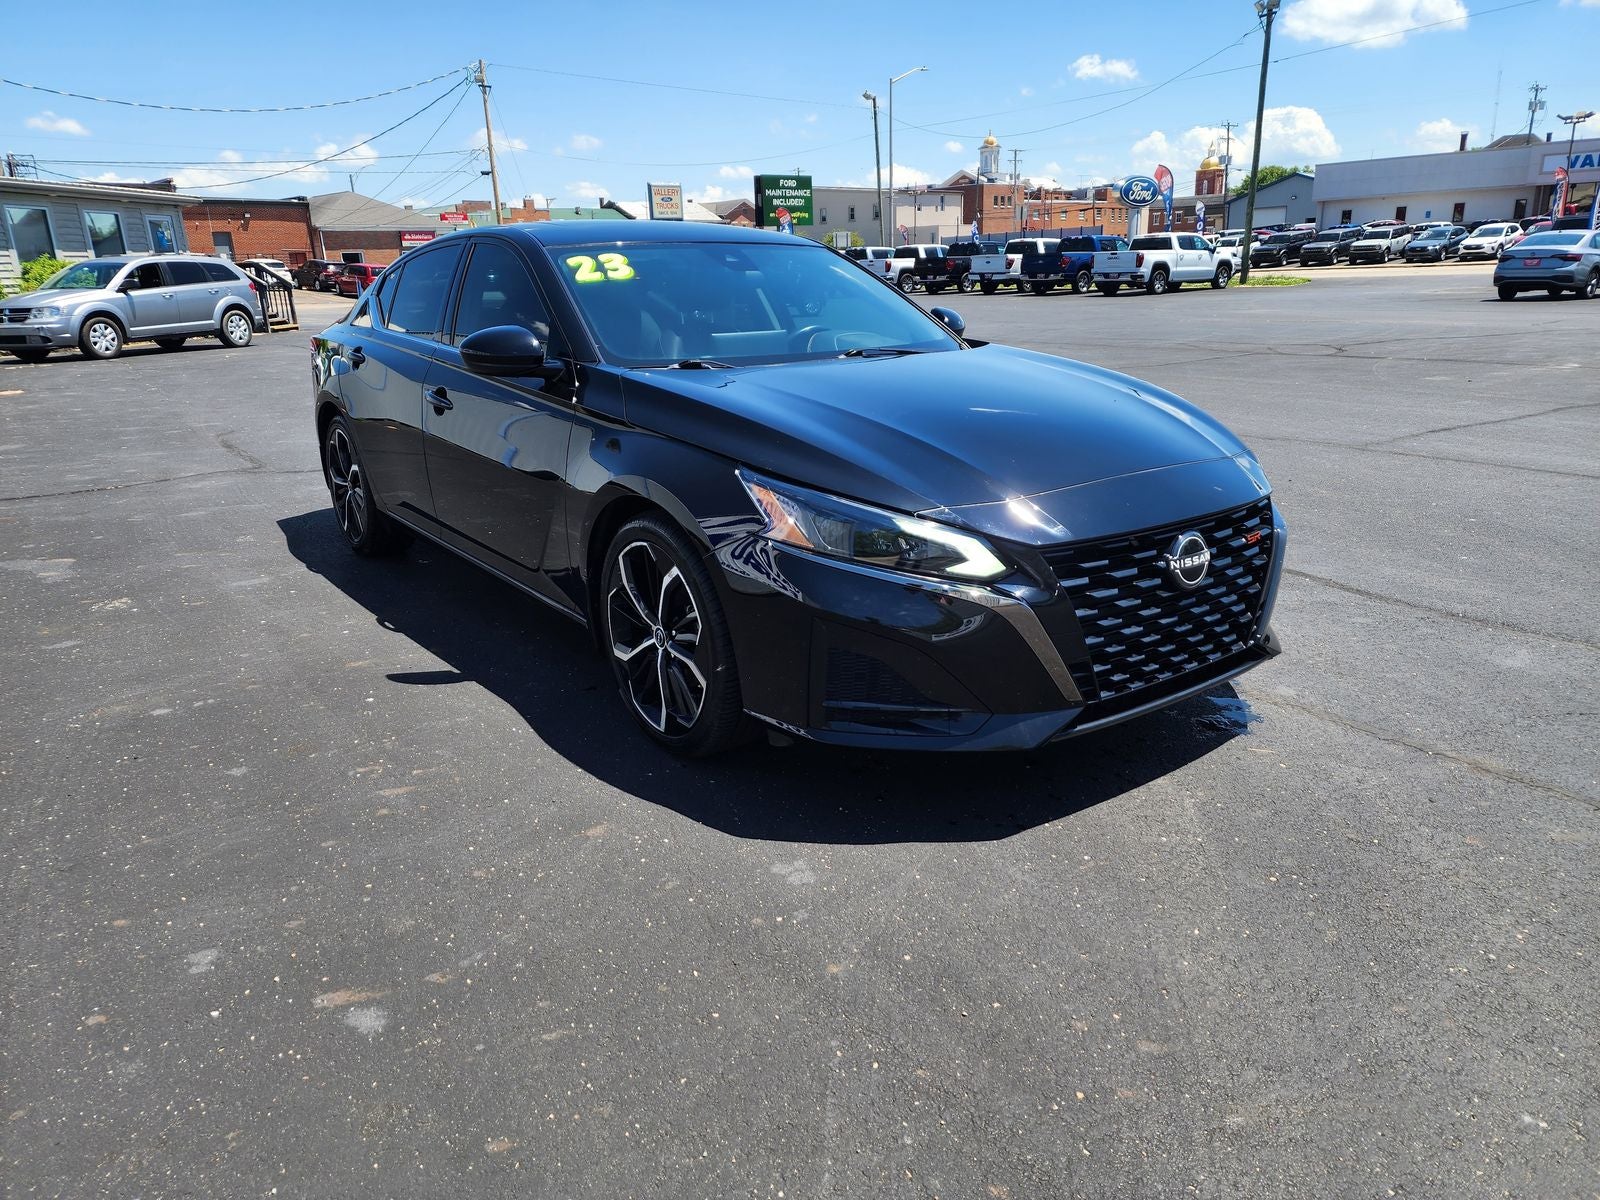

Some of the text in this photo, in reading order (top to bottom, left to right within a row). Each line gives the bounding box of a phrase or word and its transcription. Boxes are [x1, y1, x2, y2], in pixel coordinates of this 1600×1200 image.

[1567, 154, 1600, 168] VA
[653, 188, 679, 196] VALLERY
[766, 189, 811, 197] MAINTENANCE
[1129, 181, 1153, 201] Ford
[773, 198, 805, 206] INCLUDED!
[566, 252, 635, 283] 23
[1170, 550, 1210, 569] NISSAN
